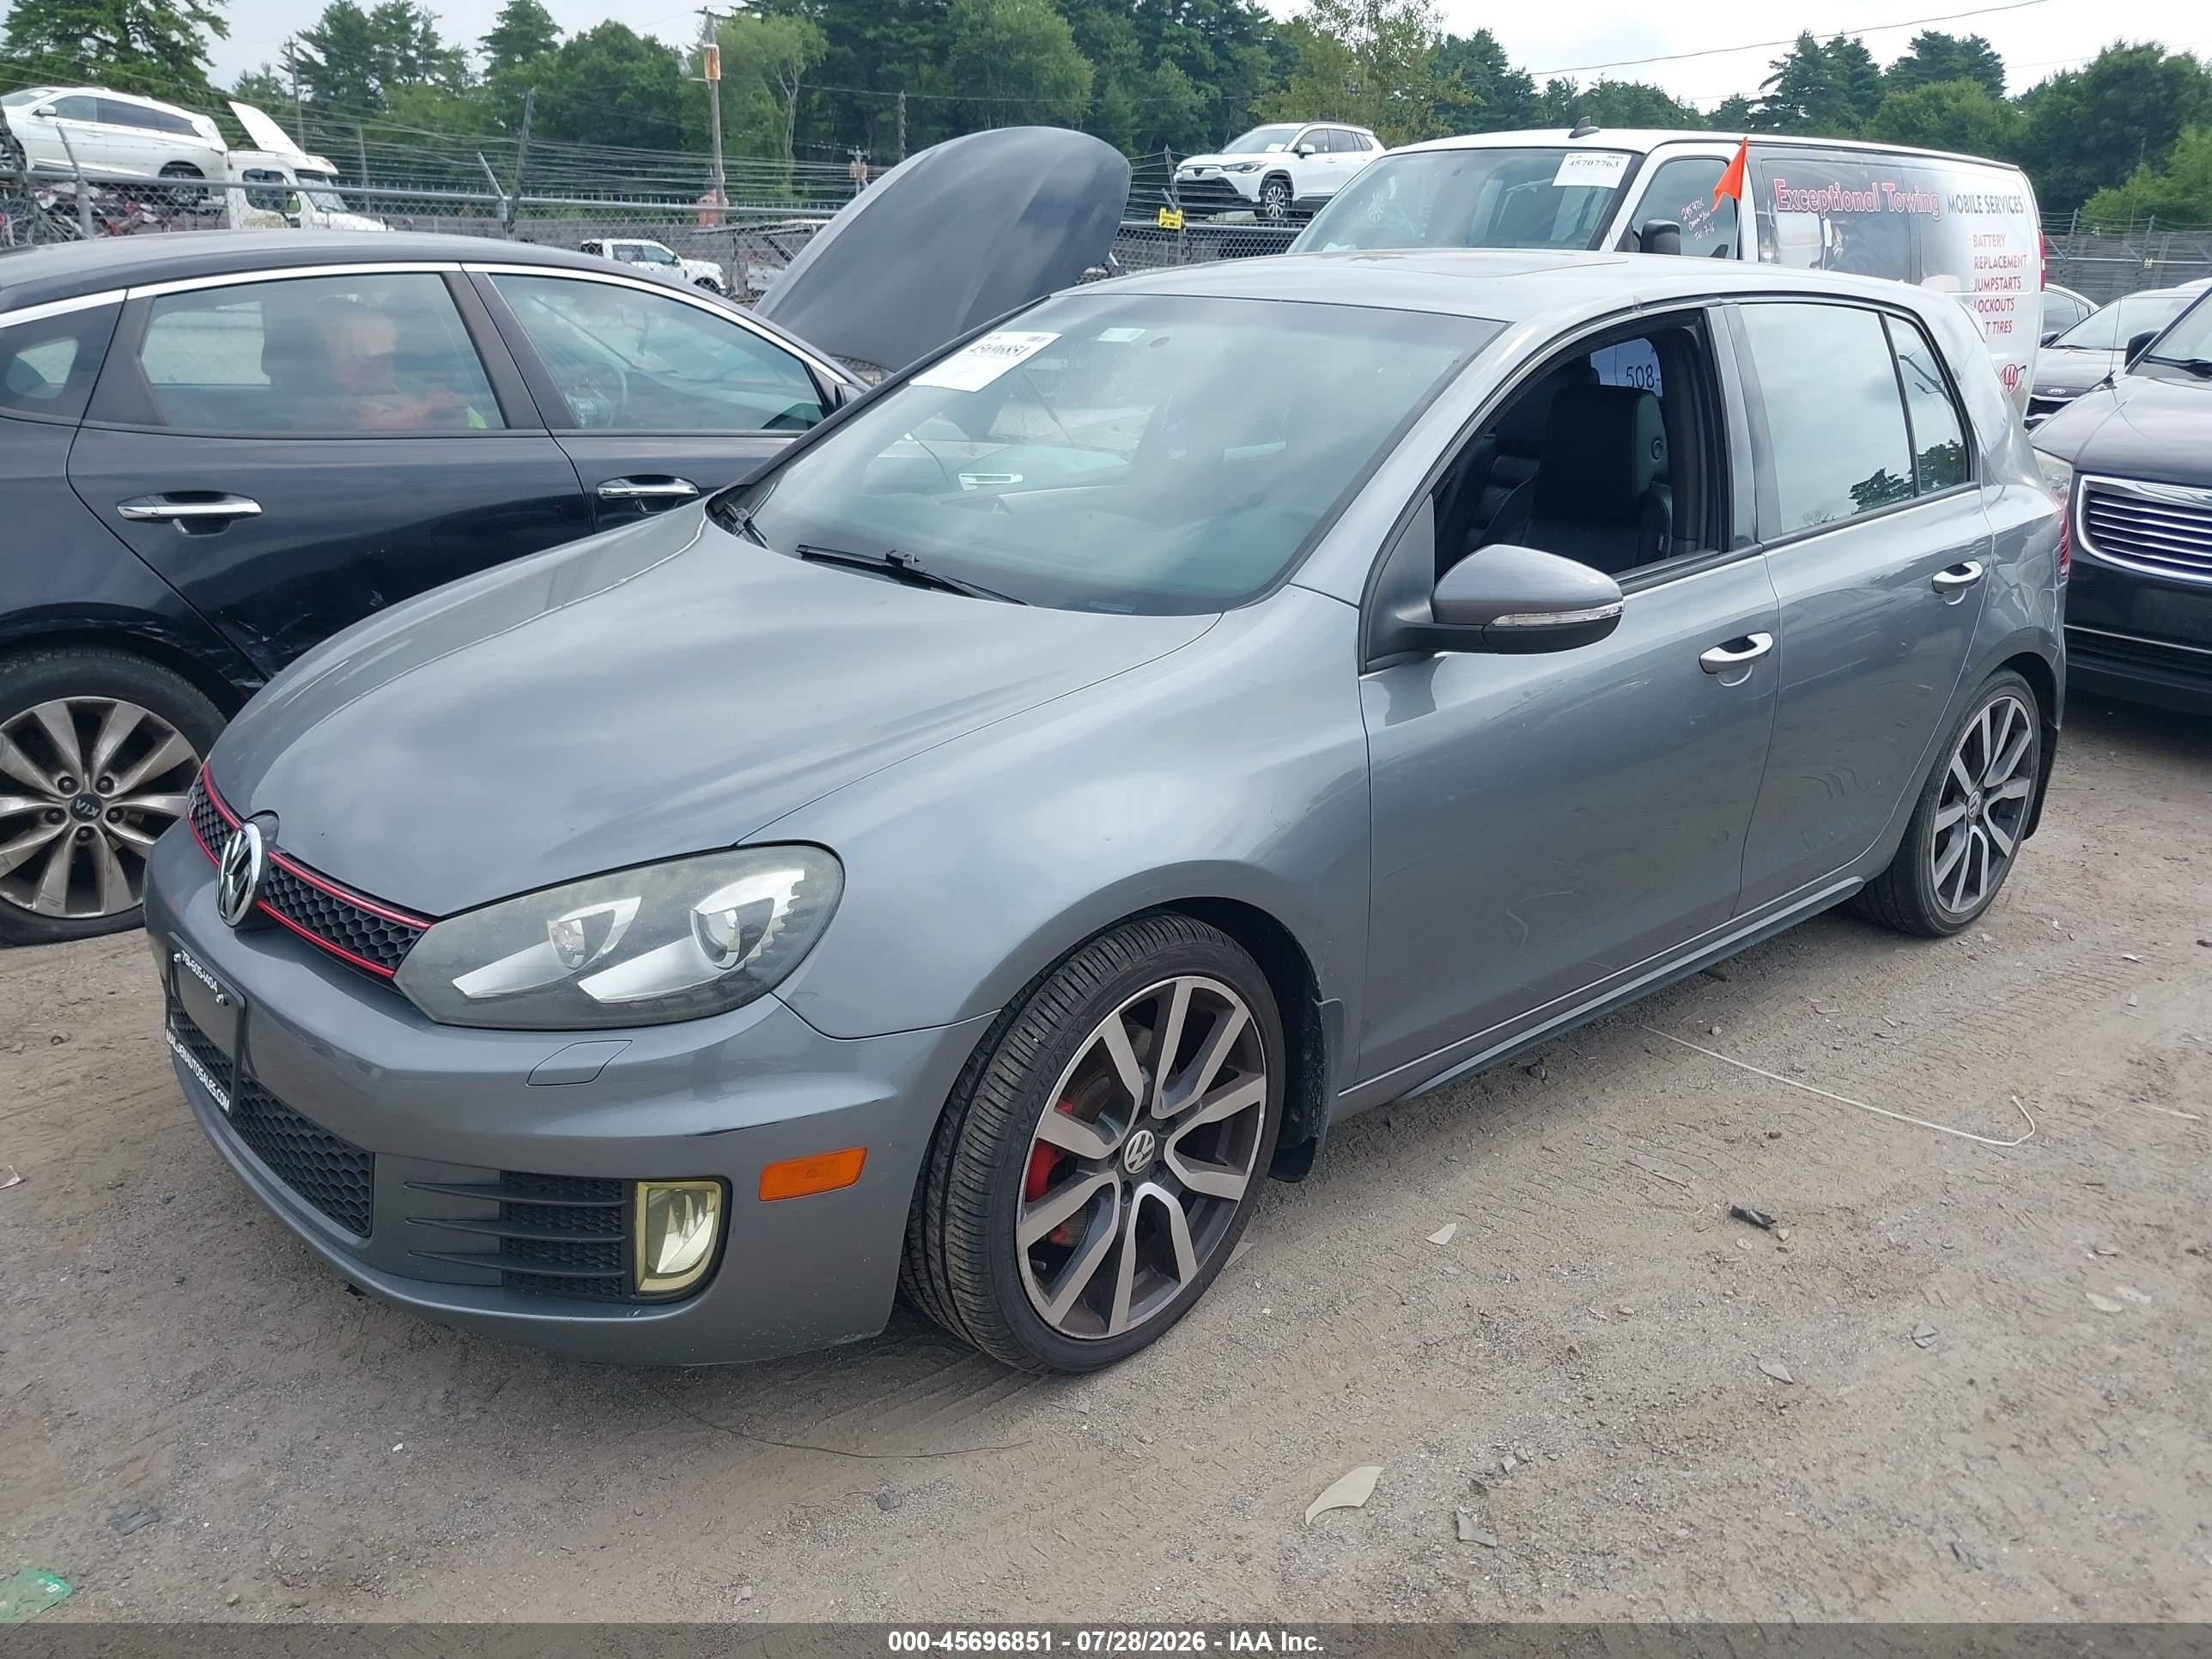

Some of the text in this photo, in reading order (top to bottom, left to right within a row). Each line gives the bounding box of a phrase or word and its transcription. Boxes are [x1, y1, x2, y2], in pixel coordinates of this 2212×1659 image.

[1773, 179, 1942, 221] Exceptional Towing
[1948, 193, 2024, 214] MOBILE SERVICES
[1973, 234, 2006, 247] BATTERY
[1974, 254, 2027, 270] REPLACEMENT
[1974, 276, 2021, 292] JUMPSTARTS
[1992, 320, 2012, 334] TIRES
[1626, 364, 1661, 388] 508-
